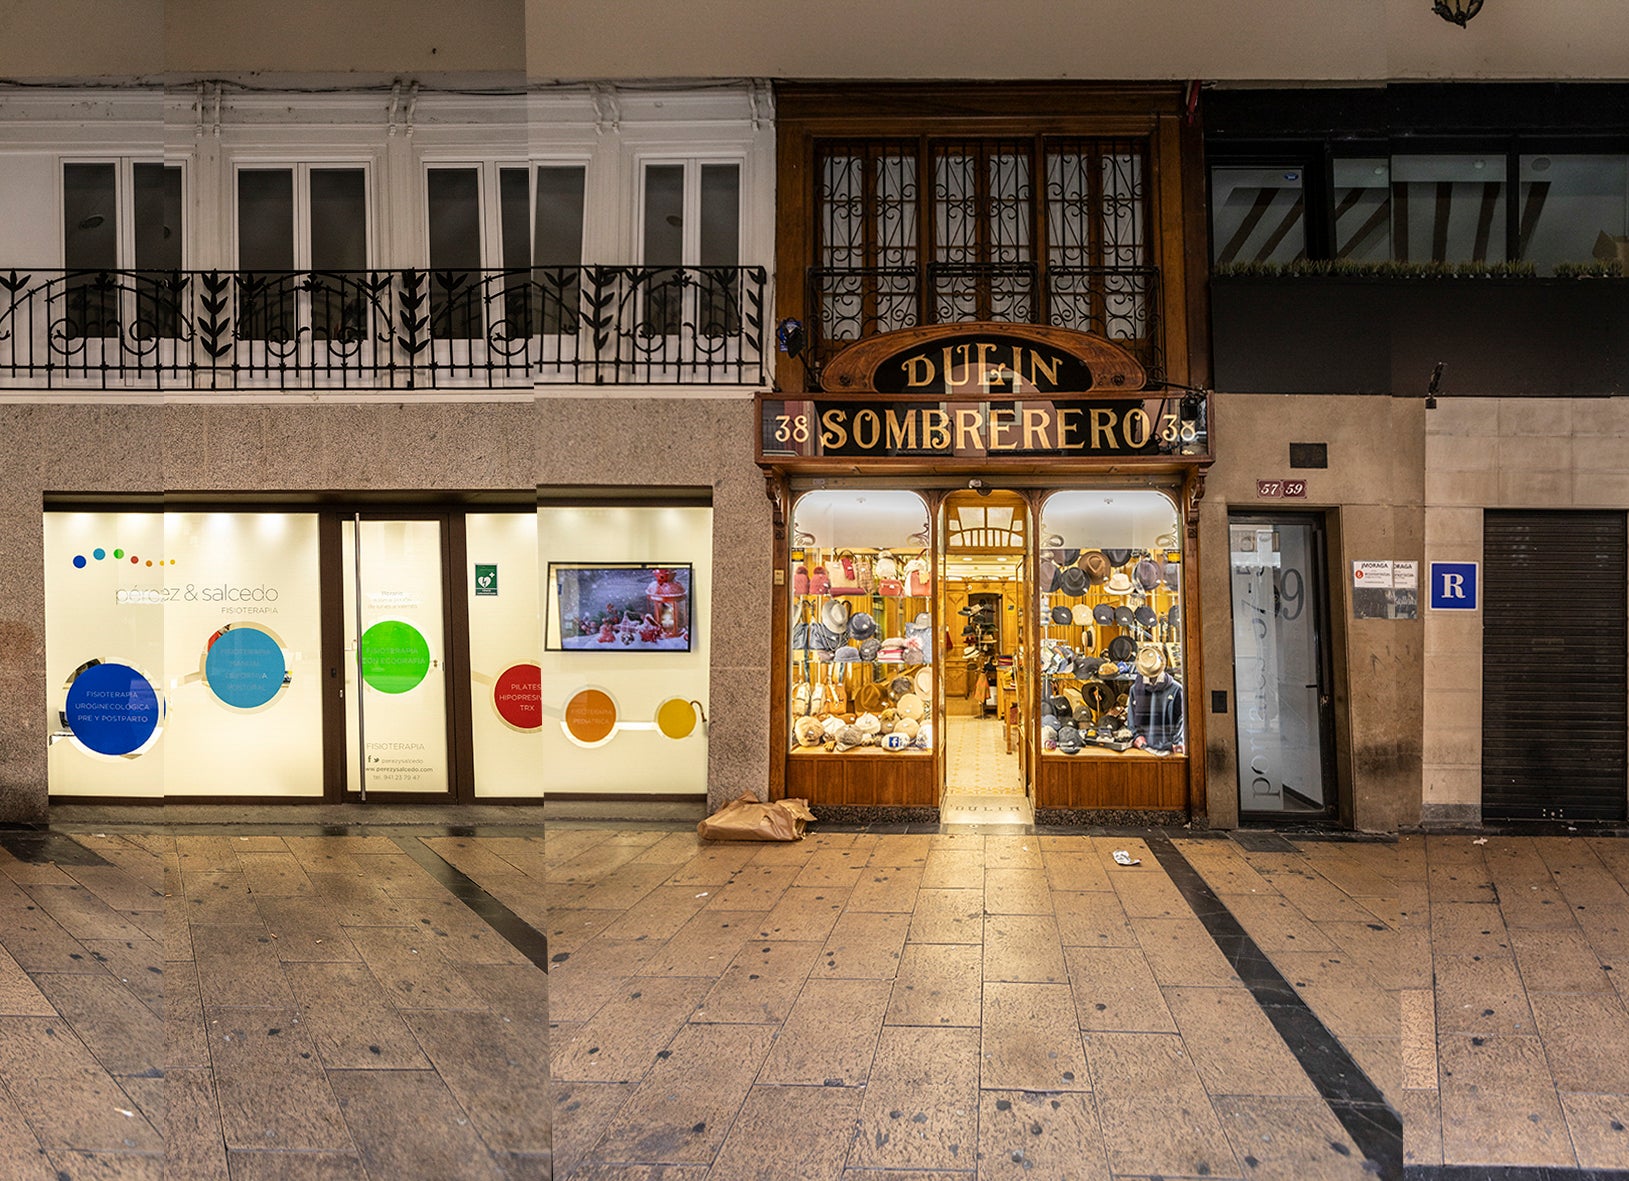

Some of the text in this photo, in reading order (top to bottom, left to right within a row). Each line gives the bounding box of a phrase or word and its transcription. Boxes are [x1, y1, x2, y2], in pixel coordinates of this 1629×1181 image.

[901, 342, 1064, 388] DULIN
[774, 414, 810, 443] 38
[819, 408, 1150, 449] SOMBRERERO
[1261, 483, 1280, 496] 57
[1285, 483, 1303, 495] 59
[1441, 573, 1466, 598] R
[184, 583, 199, 602] &
[202, 583, 279, 602] salcedo
[221, 606, 279, 614] FISIOTERAPIA
[86, 690, 139, 698] FISIOTERAPIA
[101, 715, 149, 723] POSTPARTO
[366, 742, 425, 750] FISIOTERAPIA
